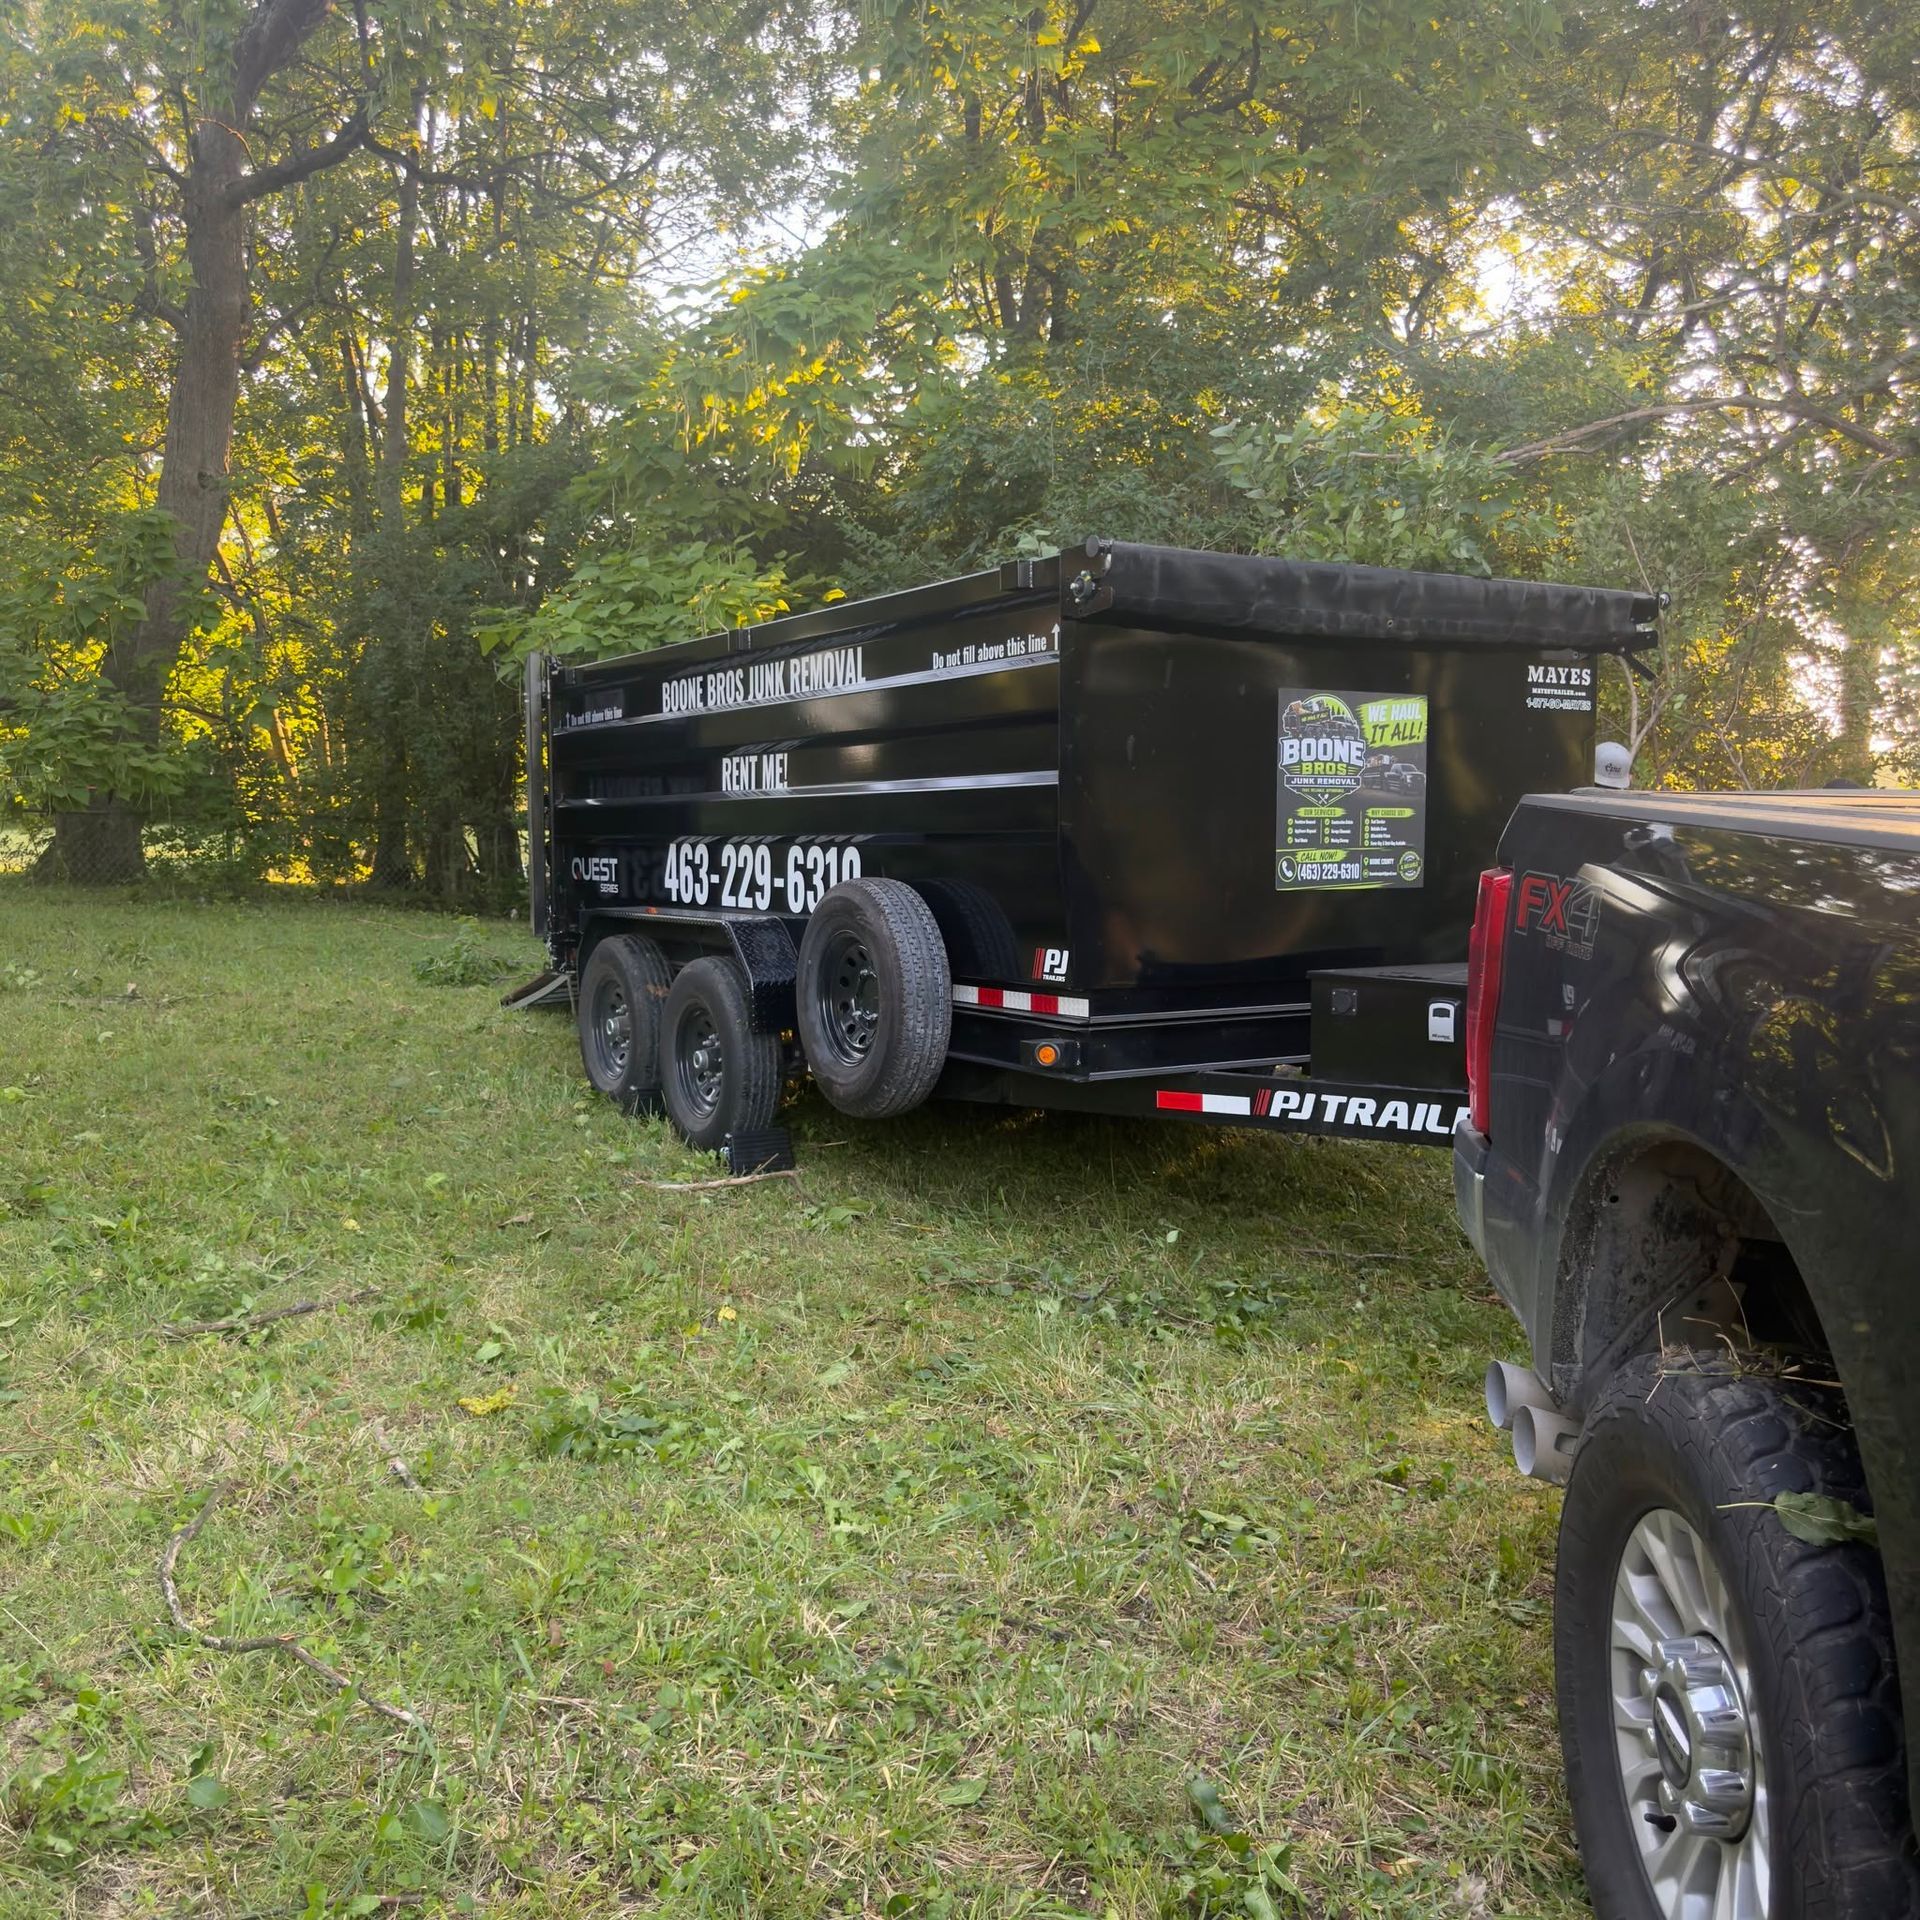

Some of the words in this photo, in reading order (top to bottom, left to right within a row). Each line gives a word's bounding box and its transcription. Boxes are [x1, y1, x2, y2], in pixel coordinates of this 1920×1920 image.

[932, 652, 944, 670] Do
[946, 649, 960, 667] not
[963, 645, 975, 664] fill
[978, 643, 1005, 661] above
[1007, 637, 1026, 657] this
[1028, 634, 1047, 653] line
[662, 676, 704, 713] BOONE
[707, 668, 745, 706] BROS
[746, 660, 786, 701] JUNK
[790, 646, 867, 693] REMOVAL
[1527, 665, 1591, 686] MAYES
[1368, 704, 1386, 722] WE
[1391, 703, 1422, 721] HAUL
[1371, 723, 1389, 744] IT
[1391, 721, 1424, 742] ALL!
[1281, 738, 1364, 766] BOONE
[722, 755, 758, 792] RENT
[762, 753, 789, 790] ME!
[1302, 762, 1347, 775] BROS
[1291, 777, 1315, 785] JUNK
[1300, 852, 1316, 861] CALL
[1319, 850, 1338, 860] NOW!
[571, 857, 618, 882] QUEST
[1297, 863, 1321, 881] (463)
[1322, 863, 1360, 880] 229-6310
[600, 883, 619, 893] SERIES
[1514, 869, 1604, 947] FX4
[1043, 948, 1069, 975] PJ
[1269, 1090, 1316, 1121] PJ
